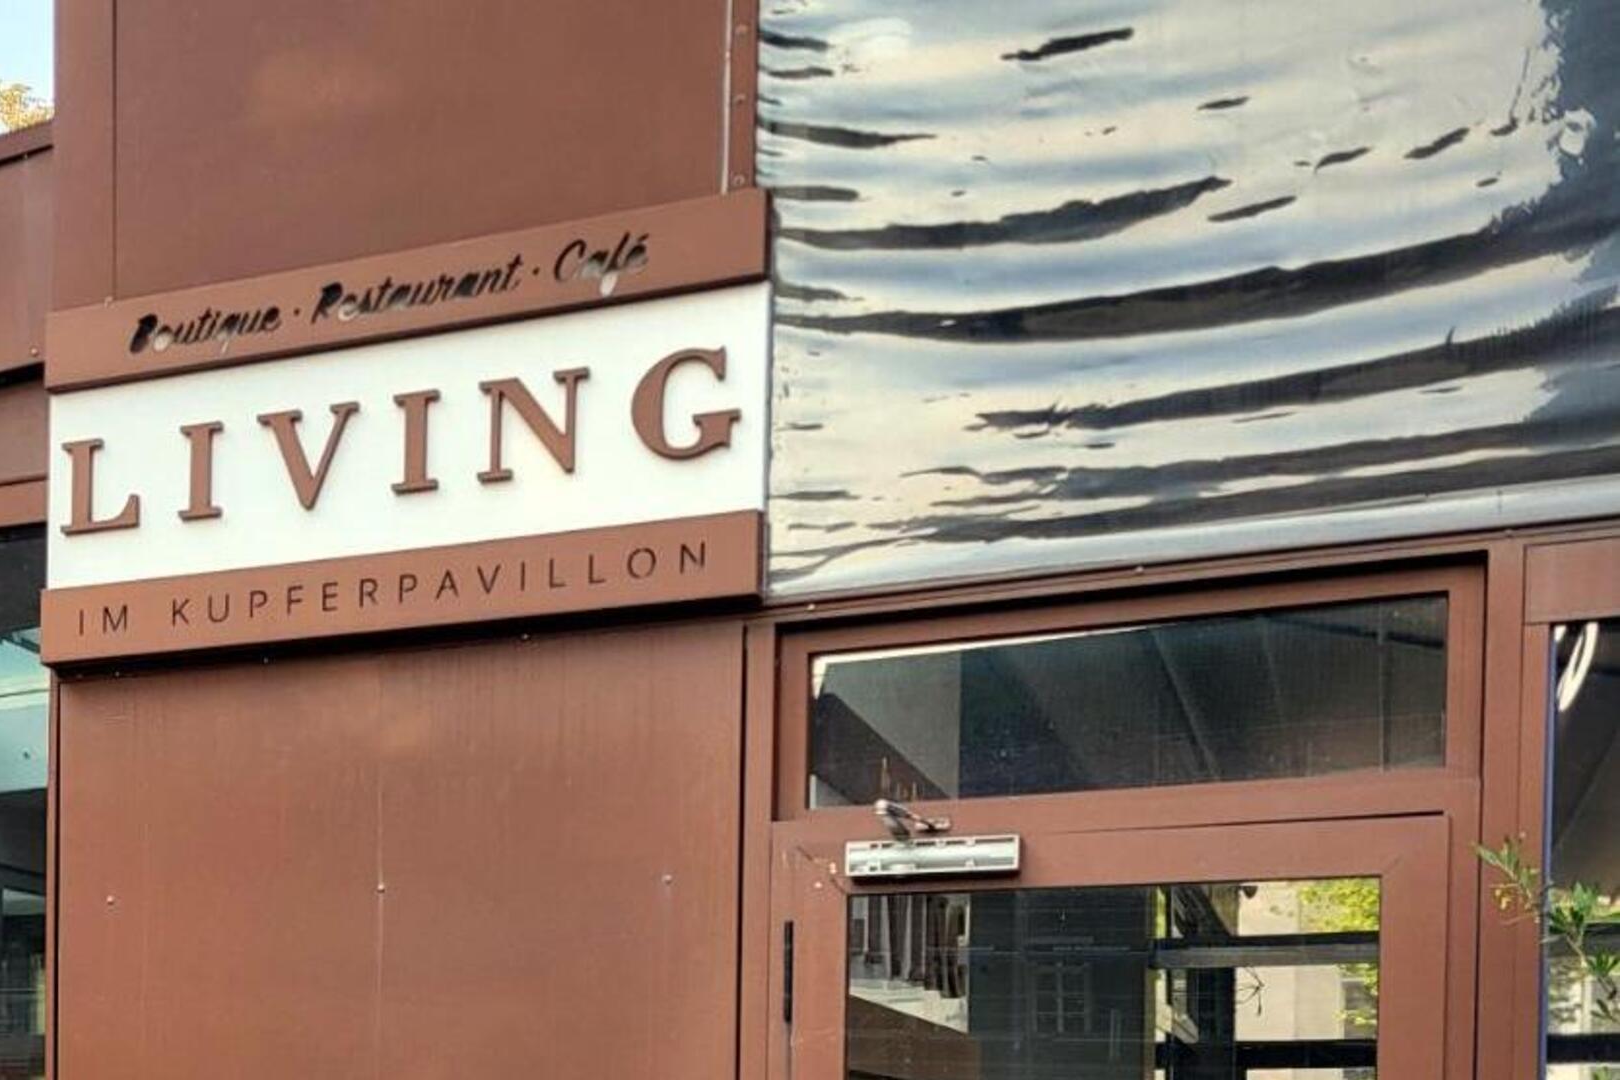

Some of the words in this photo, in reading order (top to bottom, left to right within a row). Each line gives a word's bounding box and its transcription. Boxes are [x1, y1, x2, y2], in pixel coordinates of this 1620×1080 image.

[129, 301, 283, 355] Boutique
[310, 252, 525, 325] Restaurant
[60, 345, 742, 537] LIVING
[77, 603, 130, 636] IM
[170, 541, 708, 627] KUPFERPAVILLON
